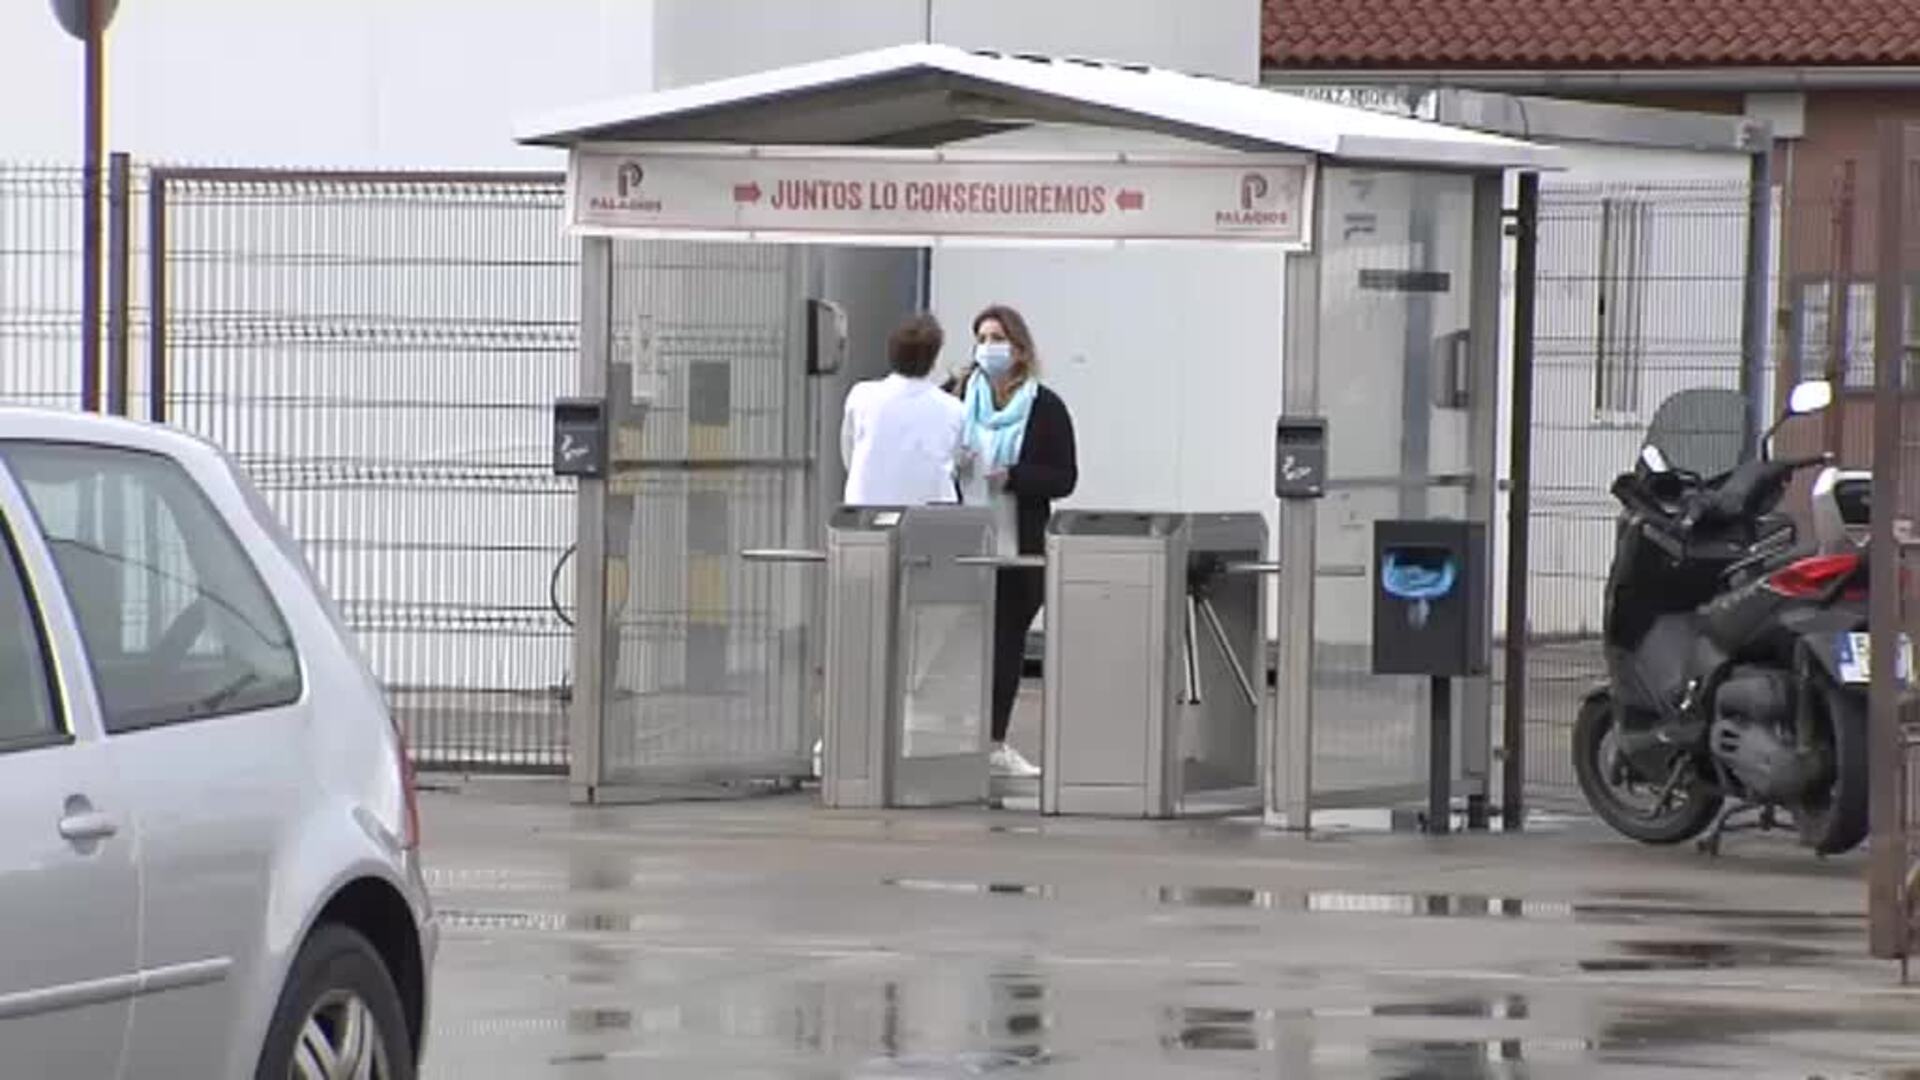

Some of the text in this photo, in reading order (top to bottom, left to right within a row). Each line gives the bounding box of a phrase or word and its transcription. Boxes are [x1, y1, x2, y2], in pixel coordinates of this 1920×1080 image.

[771, 179, 1106, 214] JUNTOS LO CONSEGUIREMOS
[590, 197, 662, 212] PALACIOS
[1215, 211, 1288, 225] PALACIOS
